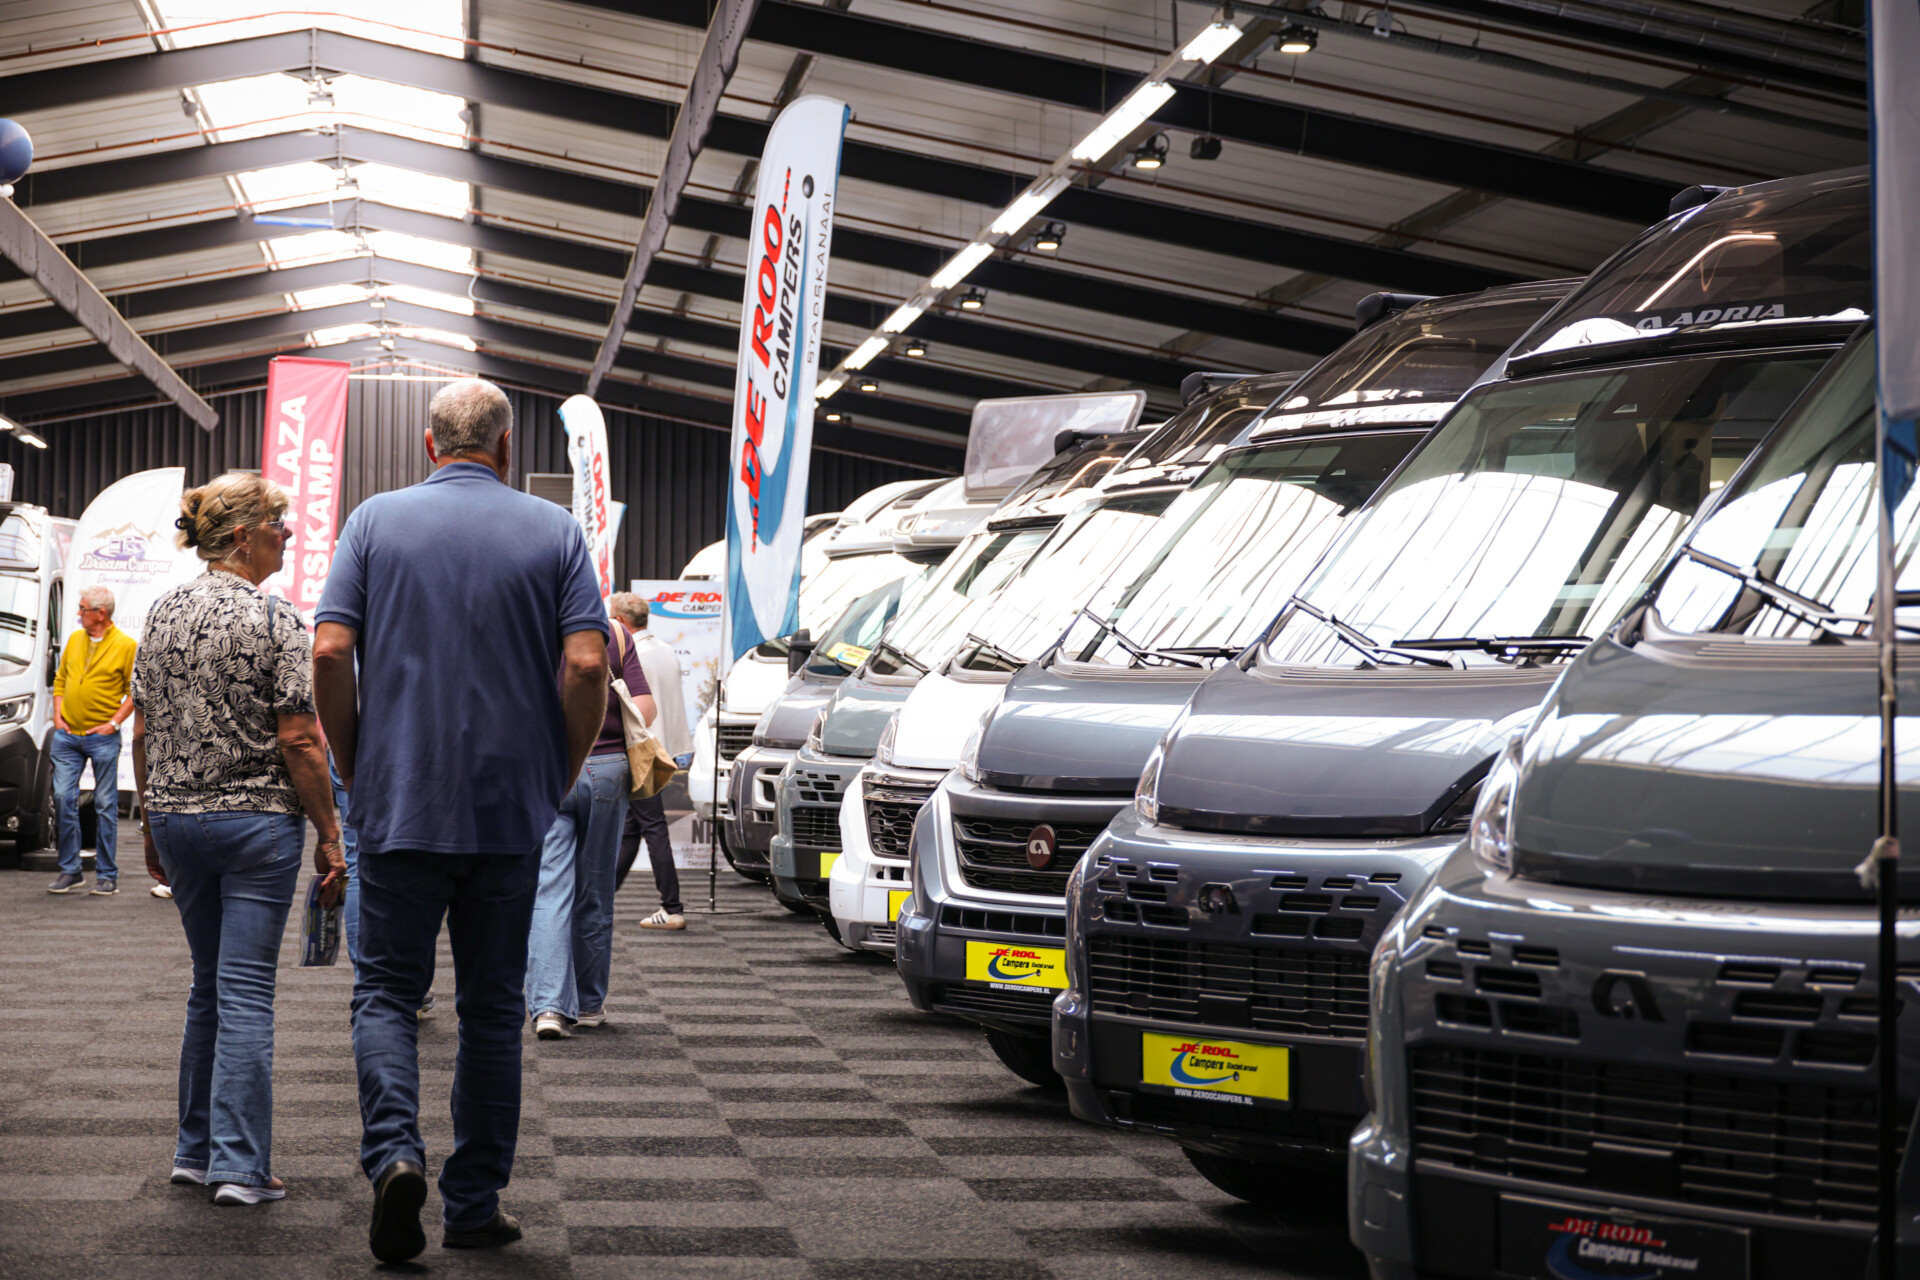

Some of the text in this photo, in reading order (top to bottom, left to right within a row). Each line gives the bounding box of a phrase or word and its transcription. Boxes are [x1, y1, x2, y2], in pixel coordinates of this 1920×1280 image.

[773, 213, 802, 400] CAMPERS
[1668, 304, 1785, 328] ADRIA
[1002, 958, 1030, 969] Campers
[1189, 1056, 1225, 1071] Campers
[1174, 1088, 1253, 1105] WWW.DEROOCAMPERS.NL
[1578, 1237, 1640, 1265] Campers
